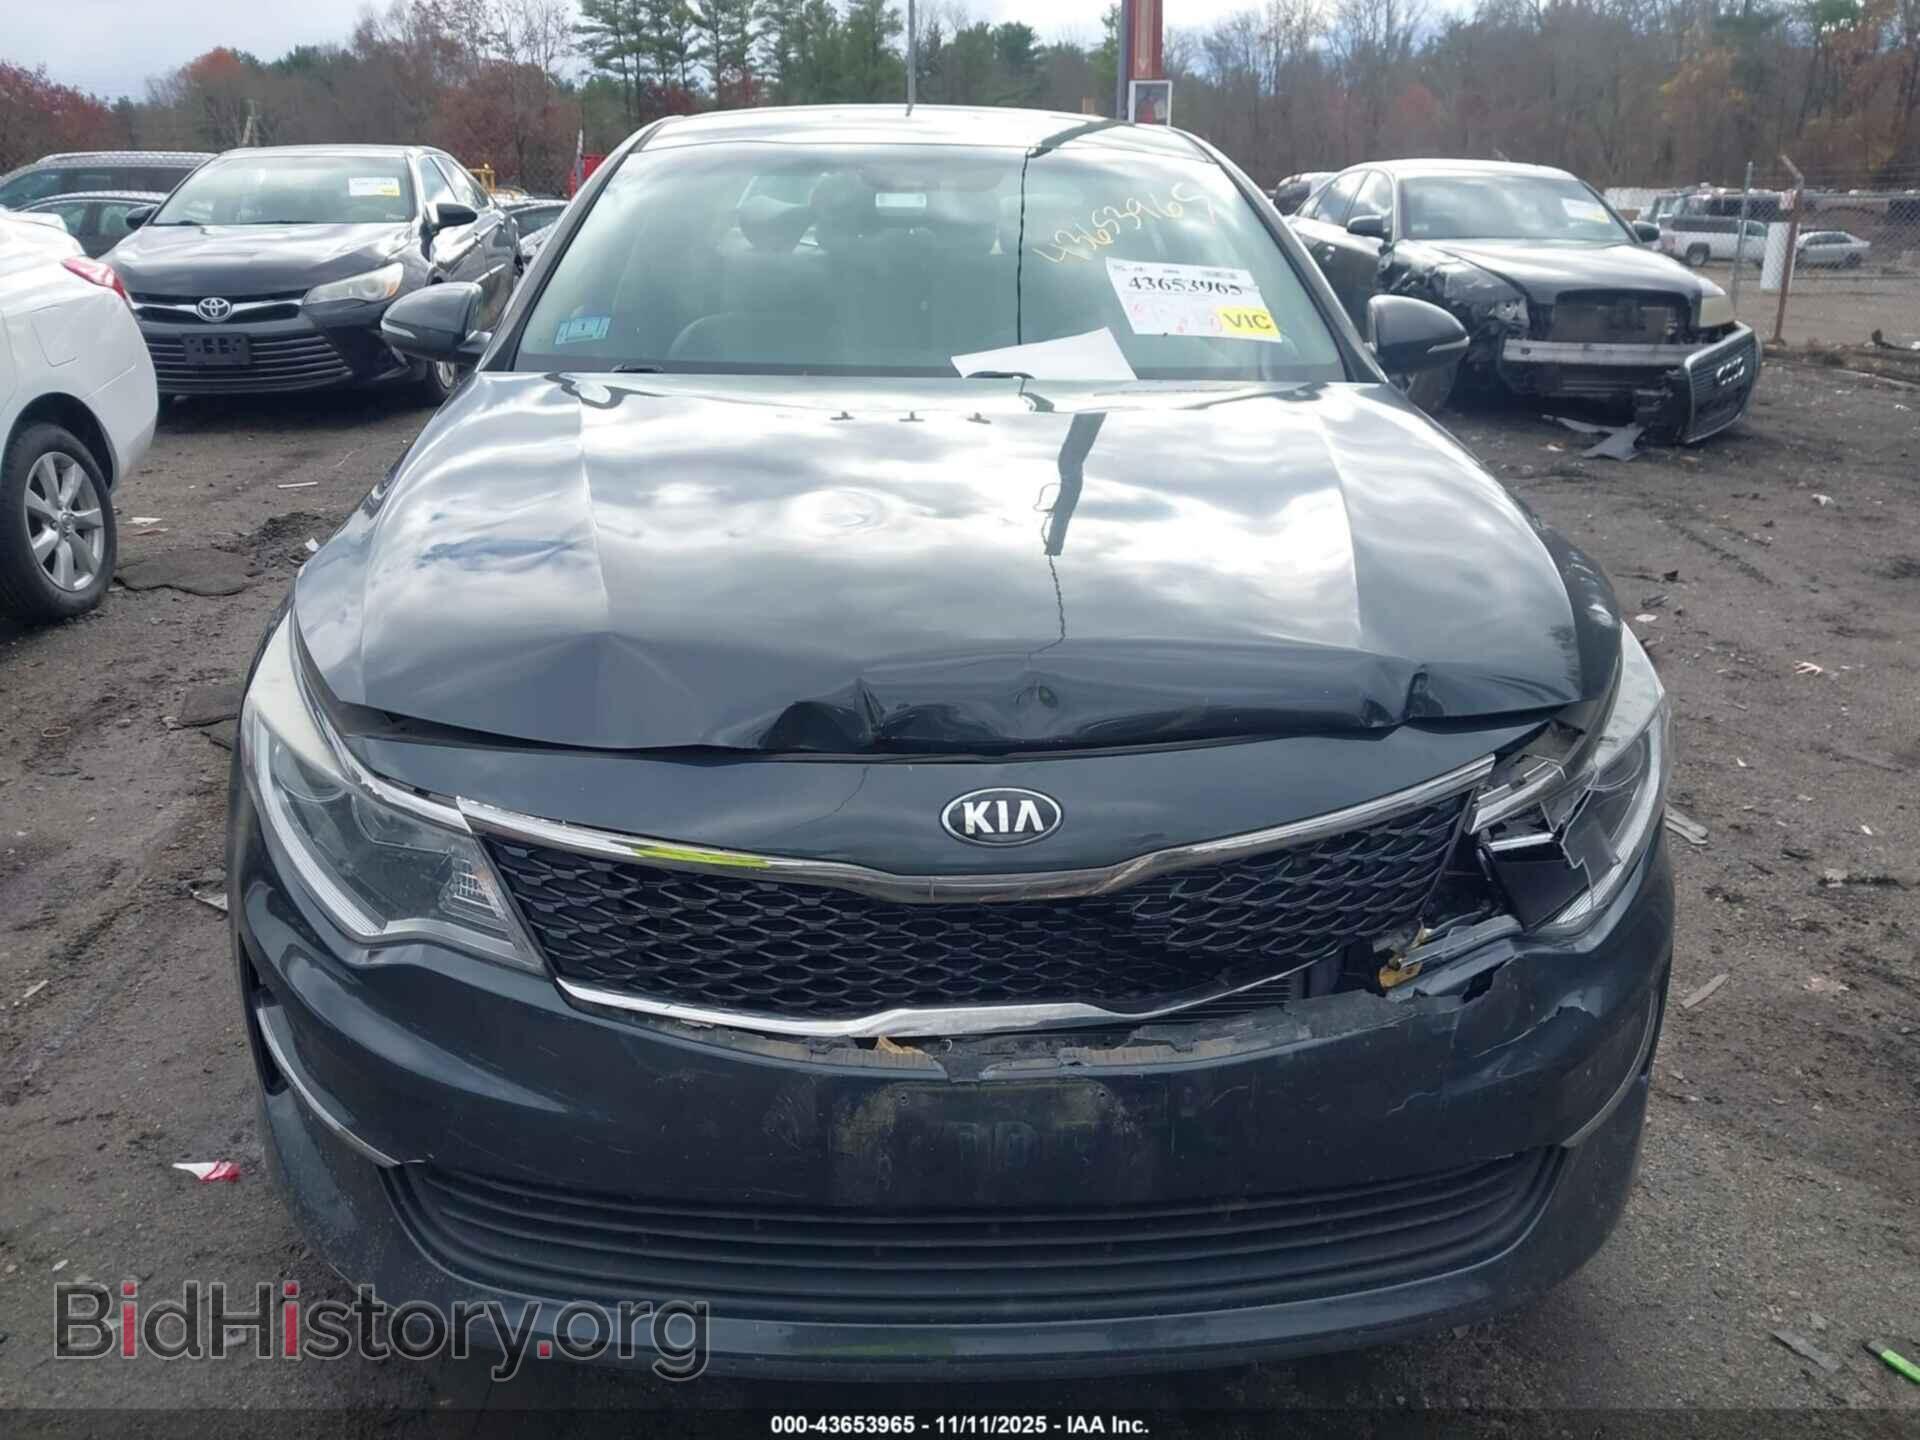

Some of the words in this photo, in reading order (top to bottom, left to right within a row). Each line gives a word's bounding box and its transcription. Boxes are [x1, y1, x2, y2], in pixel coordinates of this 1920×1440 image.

[1128, 276, 1243, 296] 43653965
[1222, 312, 1272, 331] VIC
[962, 800, 1044, 834] KIA
